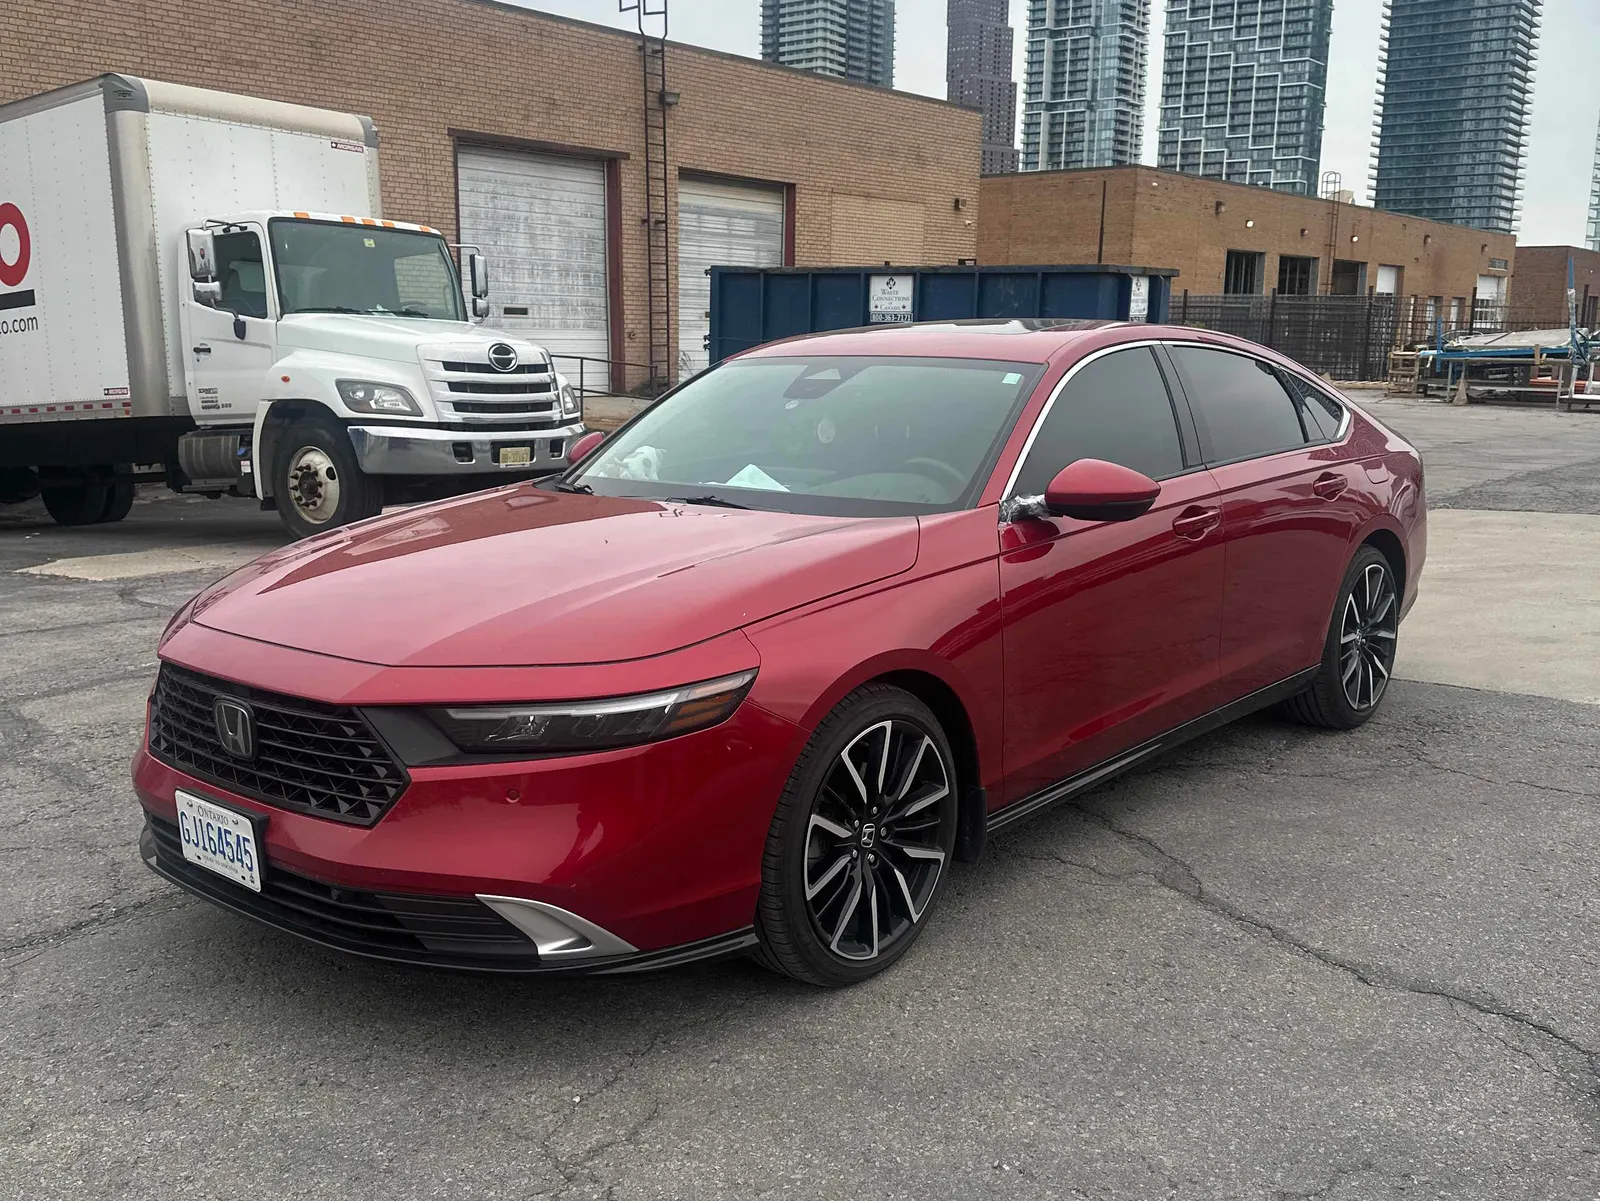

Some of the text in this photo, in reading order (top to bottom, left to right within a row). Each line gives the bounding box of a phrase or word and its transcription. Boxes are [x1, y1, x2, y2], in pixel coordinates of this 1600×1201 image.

[872, 294, 910, 302] CONNECTIONS
[881, 288, 899, 296] WASTE
[0, 316, 39, 335] o.com
[197, 805, 229, 825] ONTARIO
